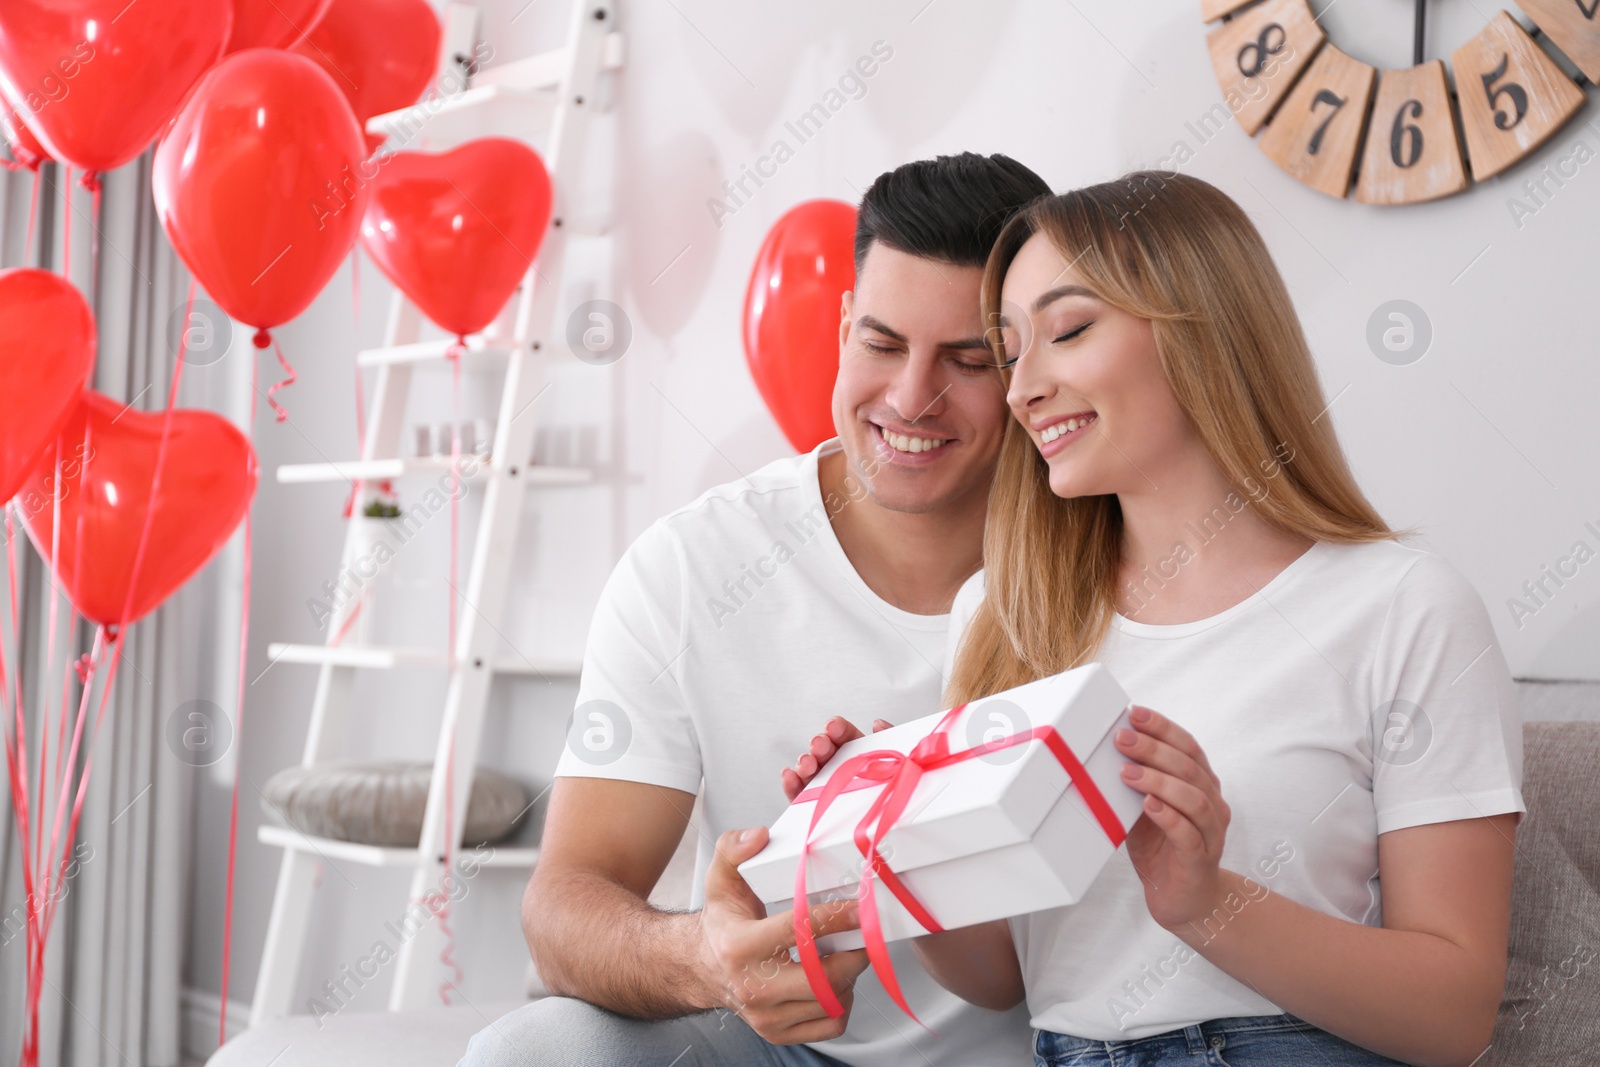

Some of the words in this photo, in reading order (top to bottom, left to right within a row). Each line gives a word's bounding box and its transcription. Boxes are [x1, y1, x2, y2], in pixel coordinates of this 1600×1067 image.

[1237, 23, 1286, 77] 8
[1307, 88, 1349, 155] 7
[1481, 53, 1528, 130] 5
[1391, 99, 1424, 169] 6
